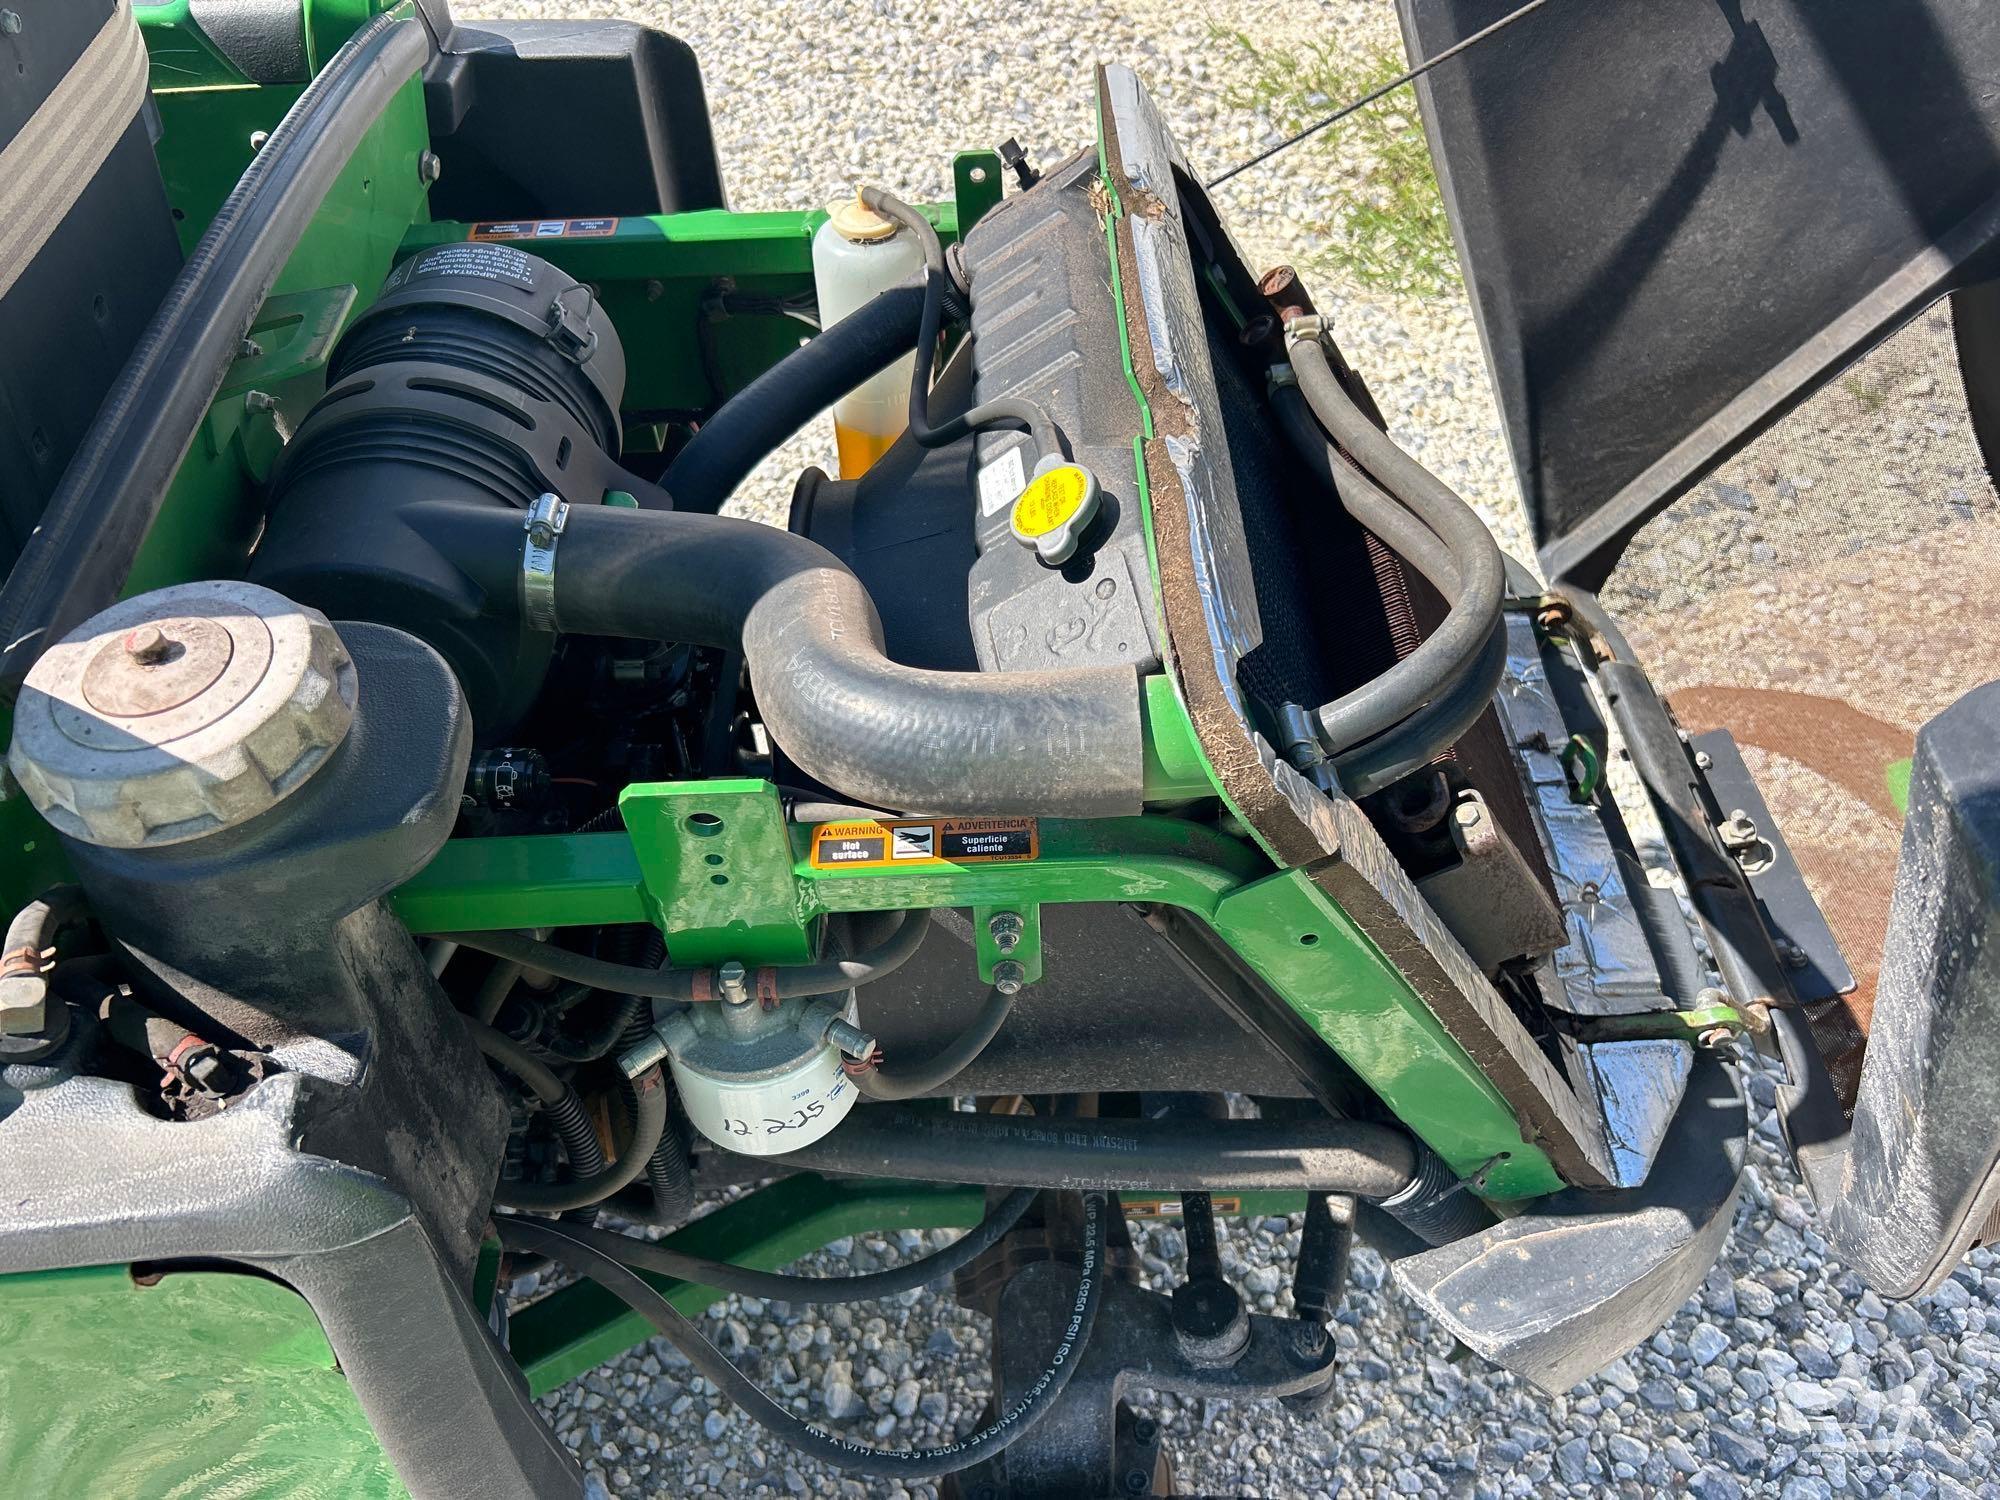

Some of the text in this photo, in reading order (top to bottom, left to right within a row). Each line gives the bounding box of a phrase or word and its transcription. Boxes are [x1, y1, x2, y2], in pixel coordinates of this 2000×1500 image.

[494, 246, 512, 255] line
[436, 248, 527, 264] when gauge reaches
[443, 252, 475, 260] cleaner
[491, 256, 526, 269] Service
[493, 262, 510, 271] not
[440, 269, 498, 279] IMPORTANT
[485, 266, 521, 279] prevent
[510, 266, 524, 274] Do
[522, 276, 534, 285] To
[957, 819, 1027, 831] ADVERTENCIA
[834, 826, 883, 836] WARNING
[961, 835, 1008, 845] Superficie
[842, 841, 860, 850] Hot
[966, 844, 1004, 853] caliente
[832, 850, 869, 860] surface
[1086, 1201, 1097, 1220] WP
[1085, 1222, 1097, 1247] 22.5
[1082, 1249, 1096, 1276] MPa
[1074, 1278, 1093, 1312] (3250
[1064, 1315, 1082, 1340] PSI)
[1053, 1343, 1071, 1365] ISO
